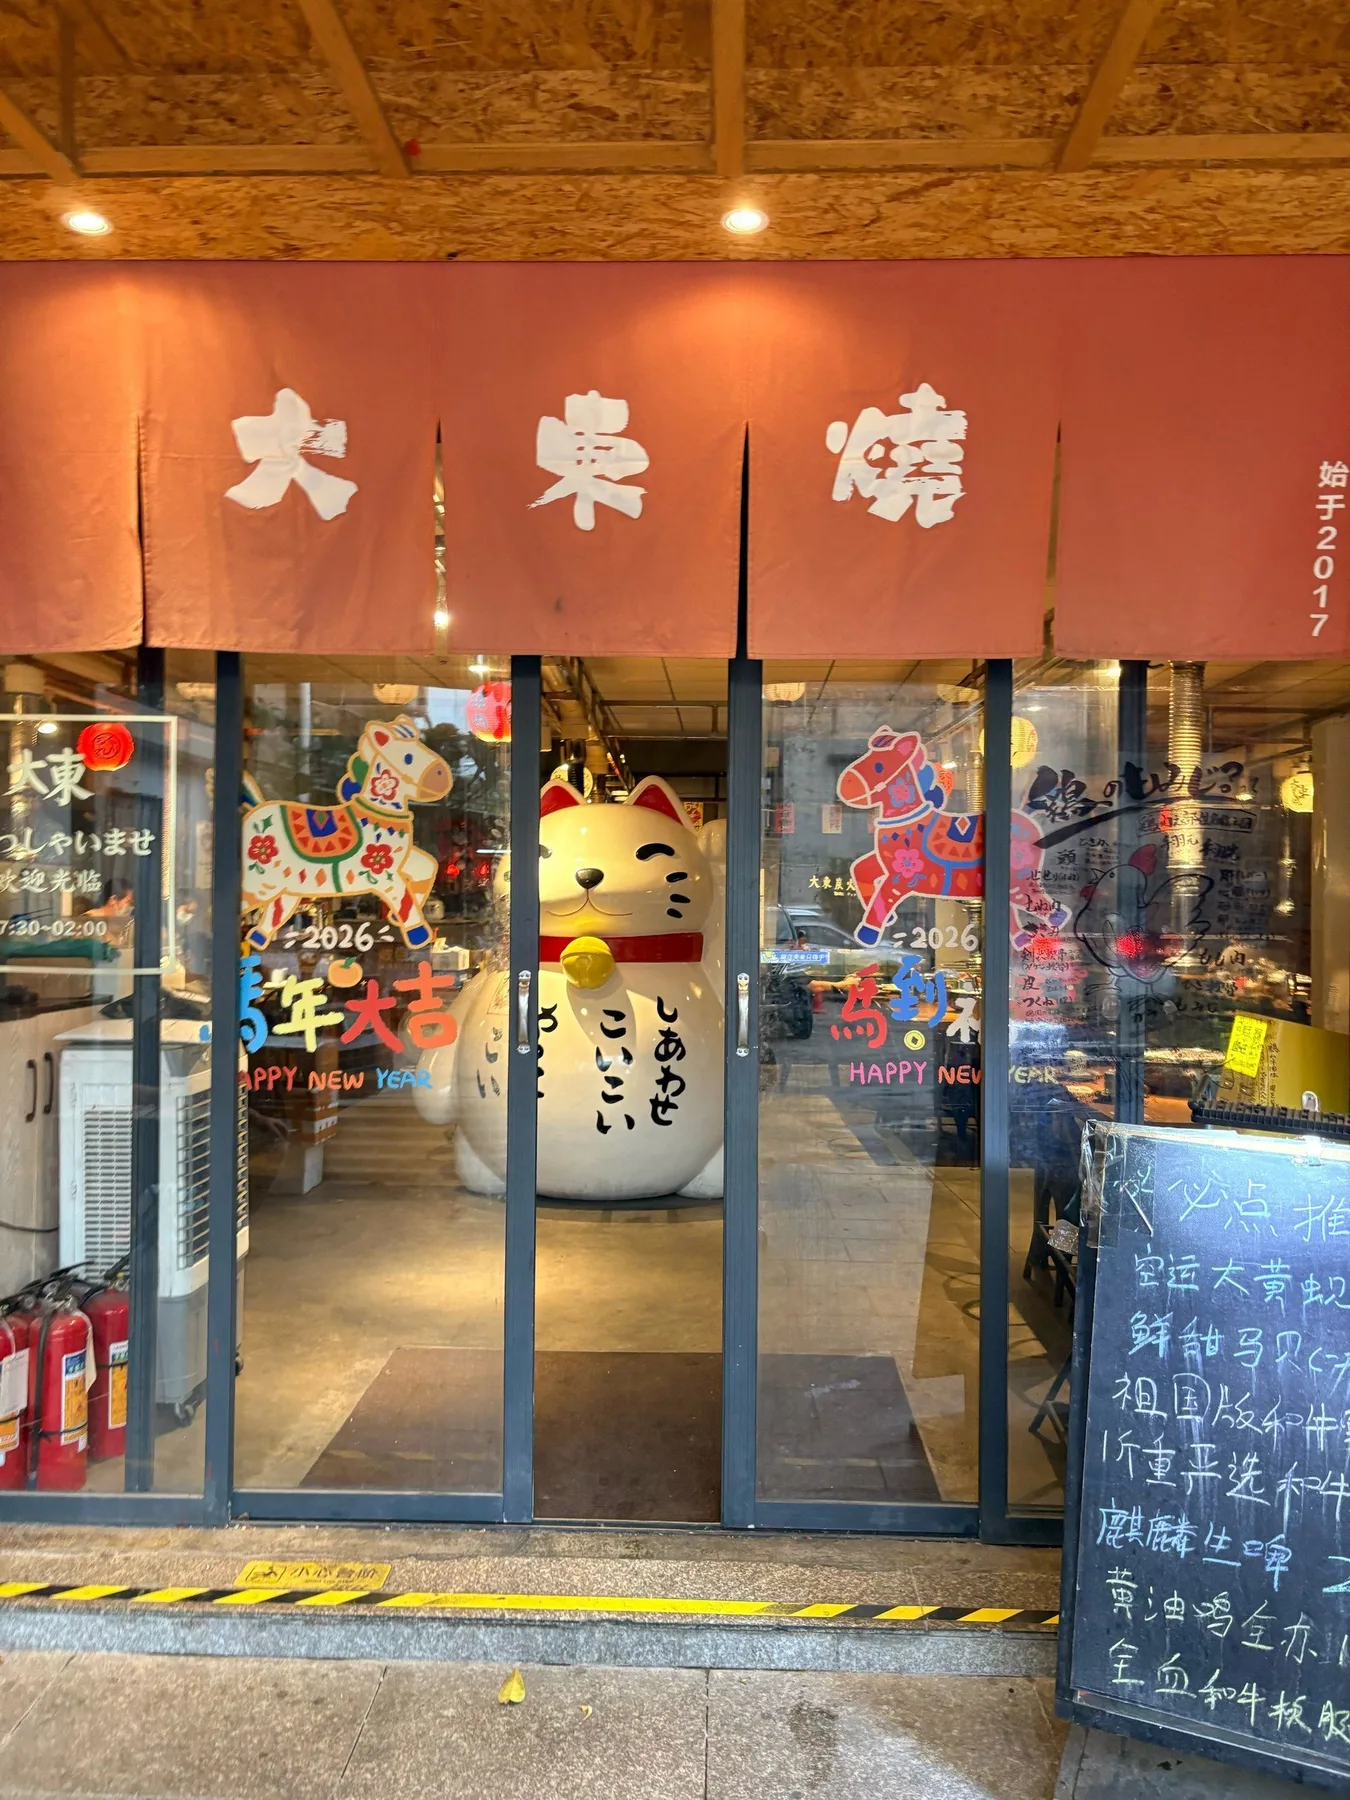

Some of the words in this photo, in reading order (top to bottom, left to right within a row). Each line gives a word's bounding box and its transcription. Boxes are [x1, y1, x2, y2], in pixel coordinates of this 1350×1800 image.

[1309, 461, 1350, 637] 始于2017
[1, 747, 96, 807] 大東
[302, 922, 375, 952] 2026
[909, 924, 980, 952] 2026
[238, 1065, 298, 1092] APPY
[308, 1070, 365, 1091] NEW
[375, 1067, 433, 1089] YEAR
[595, 1009, 636, 1135] こいこい
[649, 995, 687, 1127] しあわせ
[849, 1060, 928, 1086] HAPPY
[1112, 1371, 1350, 1450] 祖国版和牛
